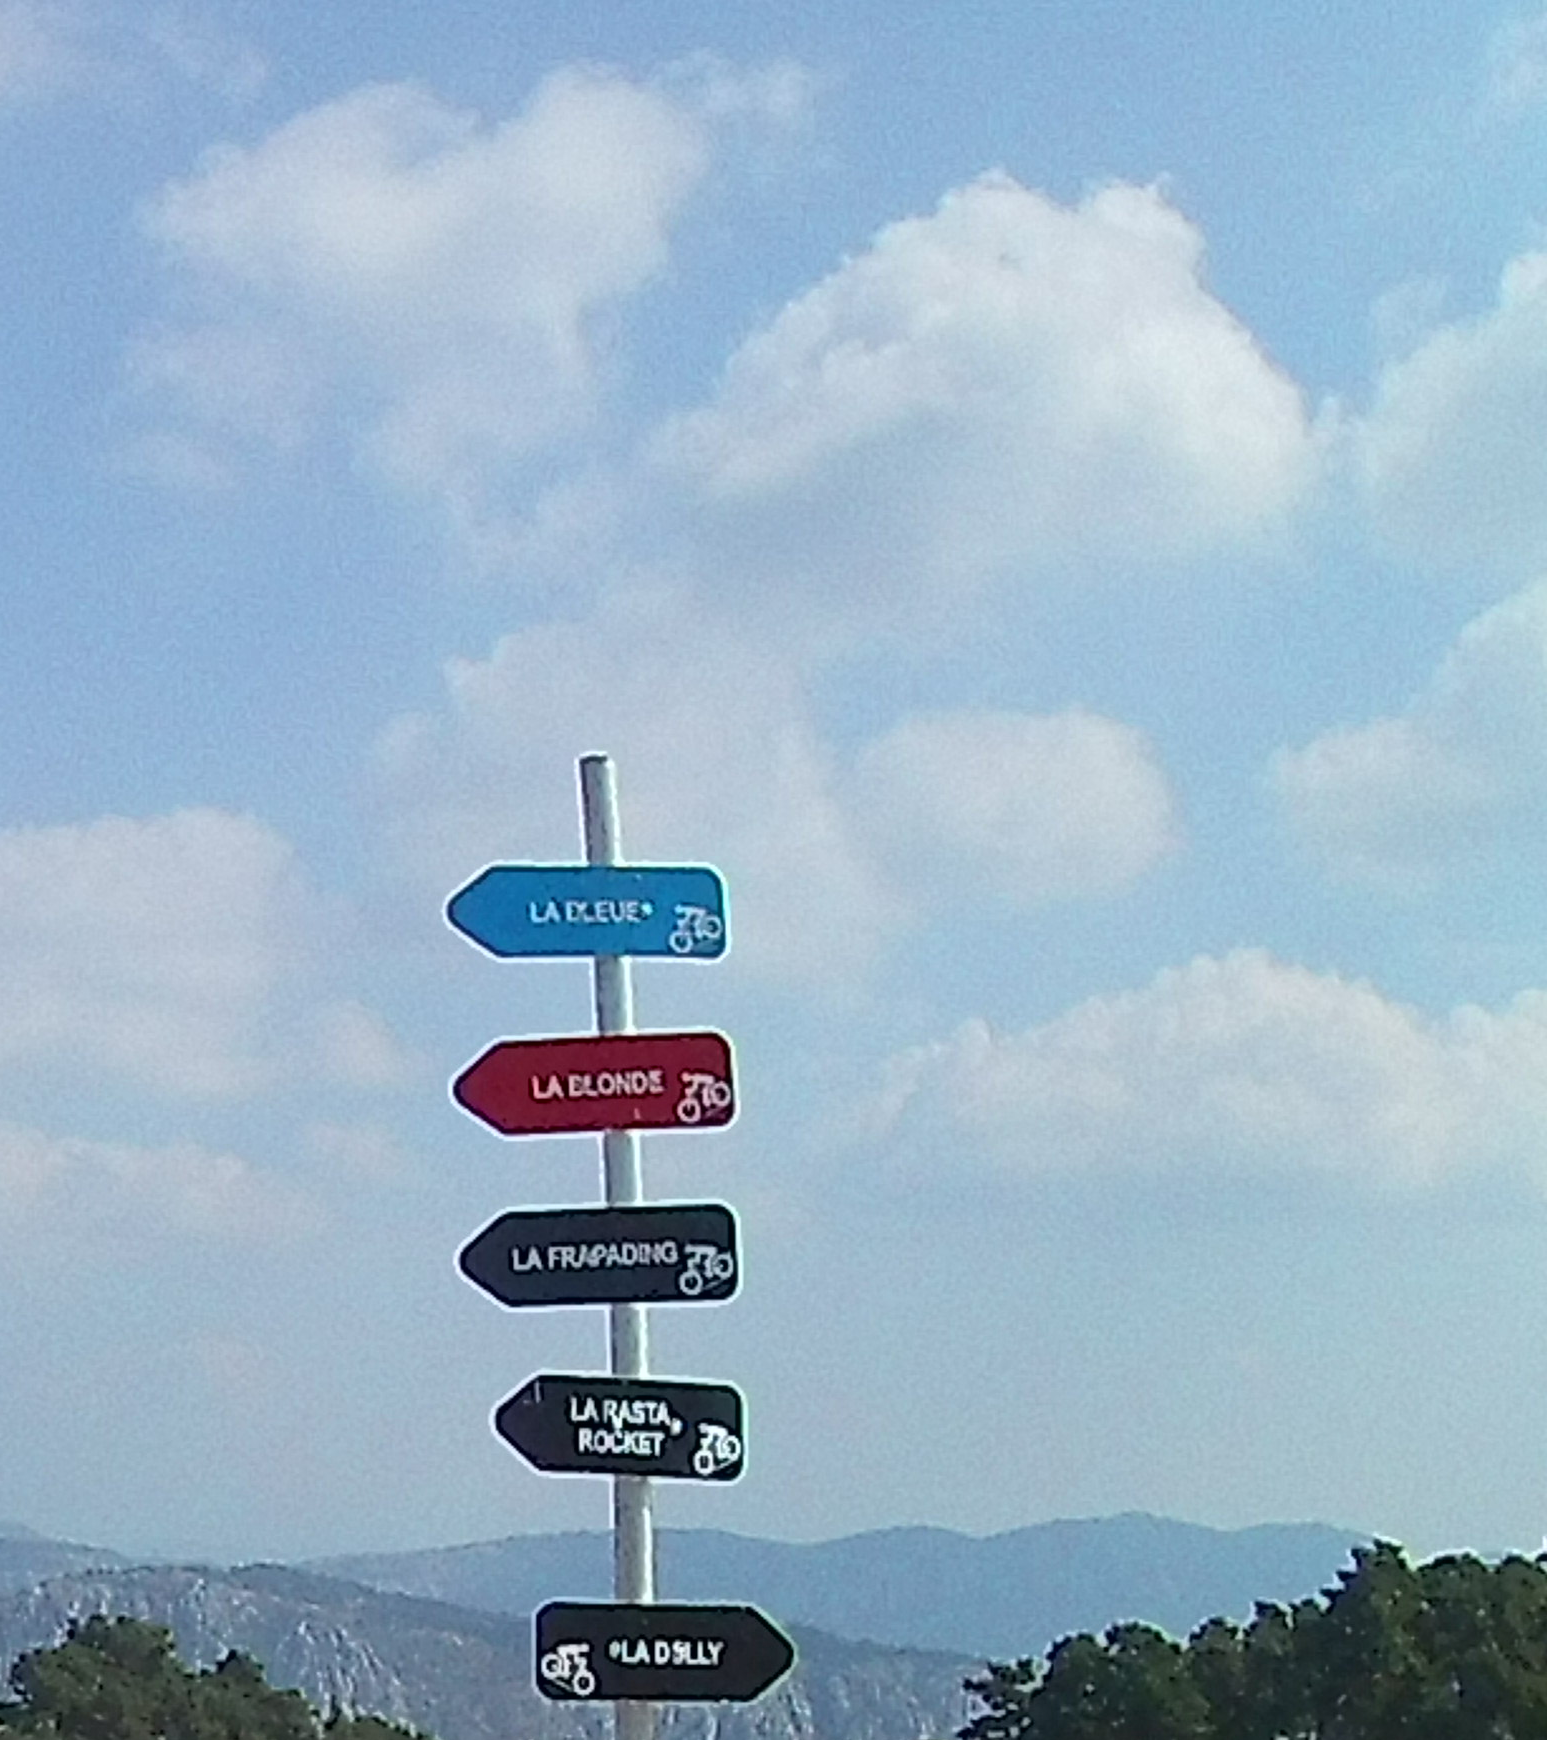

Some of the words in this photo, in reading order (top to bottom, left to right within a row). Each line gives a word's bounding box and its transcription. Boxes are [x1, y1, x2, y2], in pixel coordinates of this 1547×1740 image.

[529, 901, 560, 924] LA
[532, 1075, 564, 1100] LA
[568, 1070, 665, 1097] BLONDE
[512, 1247, 542, 1271] LA
[570, 1397, 598, 1423] LA
[603, 1399, 671, 1427] RASTA
[577, 1427, 665, 1456] ROCKET
[621, 1640, 650, 1664] LA
